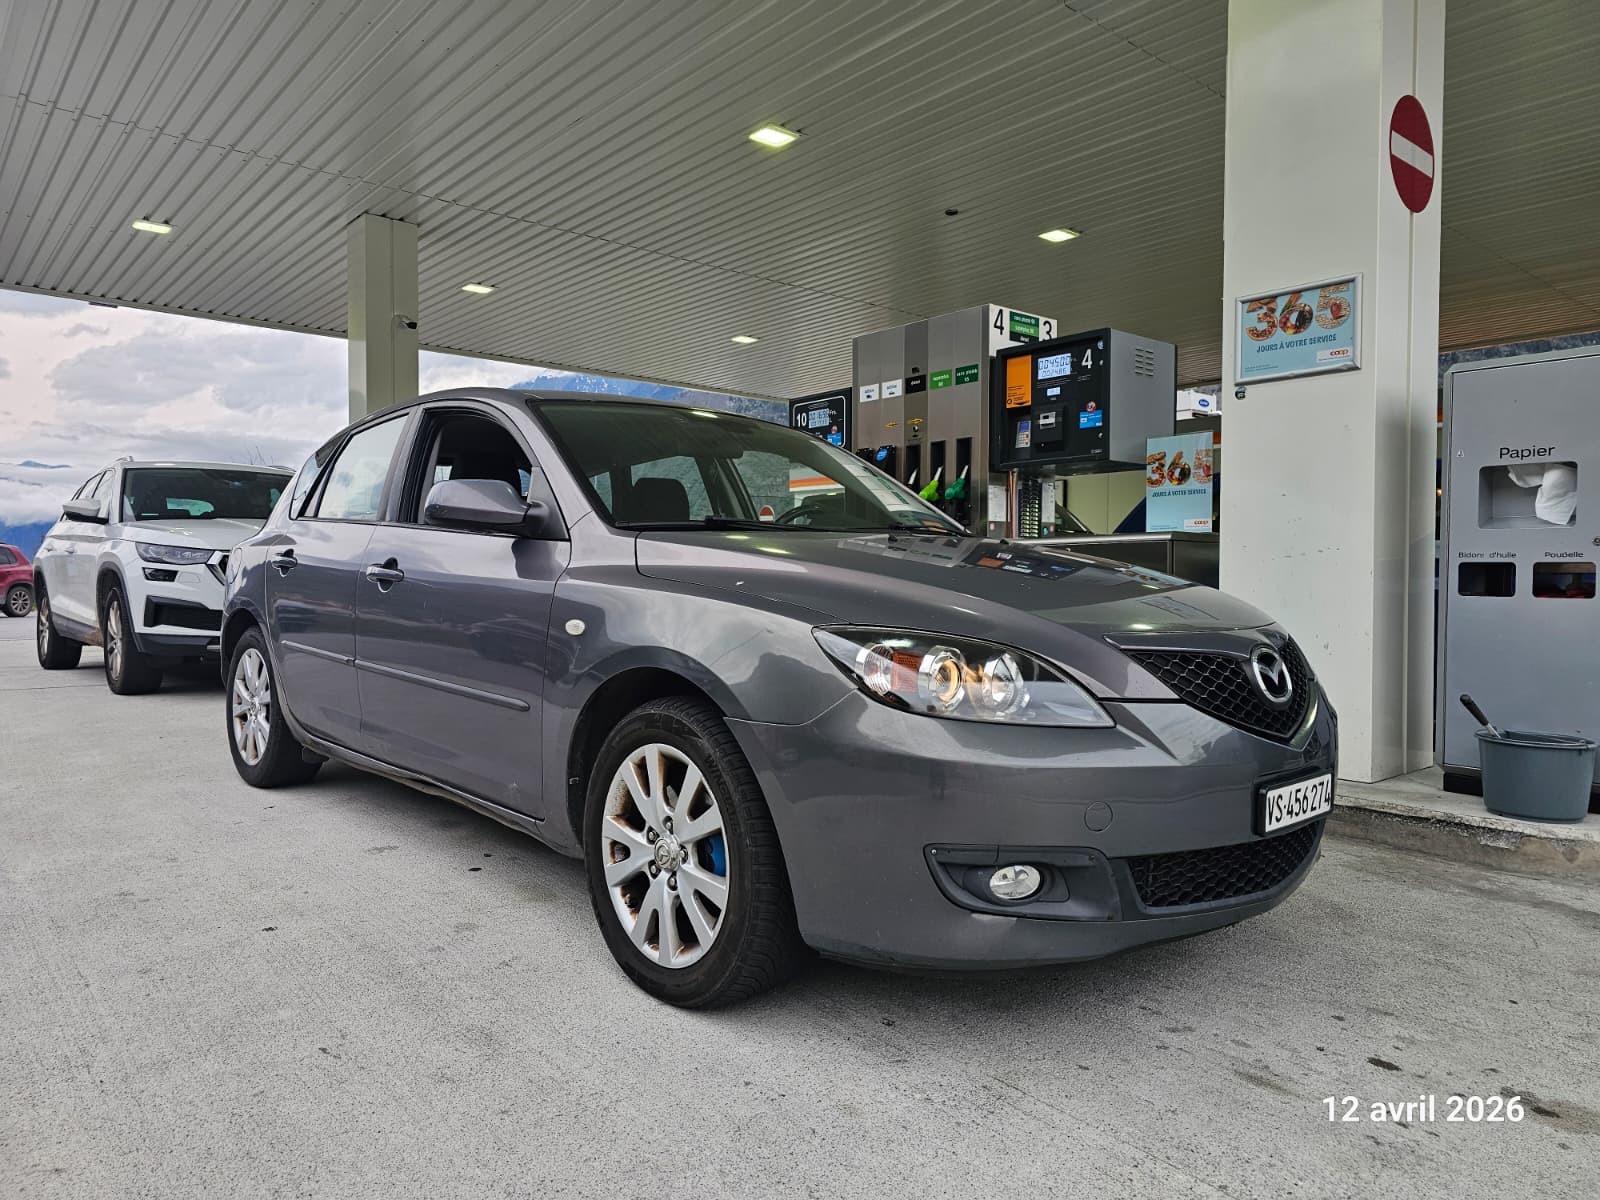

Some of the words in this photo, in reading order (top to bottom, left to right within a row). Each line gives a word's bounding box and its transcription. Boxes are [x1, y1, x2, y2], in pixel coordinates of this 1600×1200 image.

[1246, 283, 1350, 341] 365
[993, 309, 1004, 336] 4
[1043, 321, 1052, 340] 3
[1257, 343, 1278, 353] JOURS
[1279, 341, 1285, 350] À
[1285, 338, 1307, 349] VOTRE
[1309, 334, 1337, 345] SERVICE
[1082, 349, 1093, 369] 4
[796, 412, 807, 427] 10
[1500, 445, 1555, 460] Papier
[1146, 449, 1212, 488] 365
